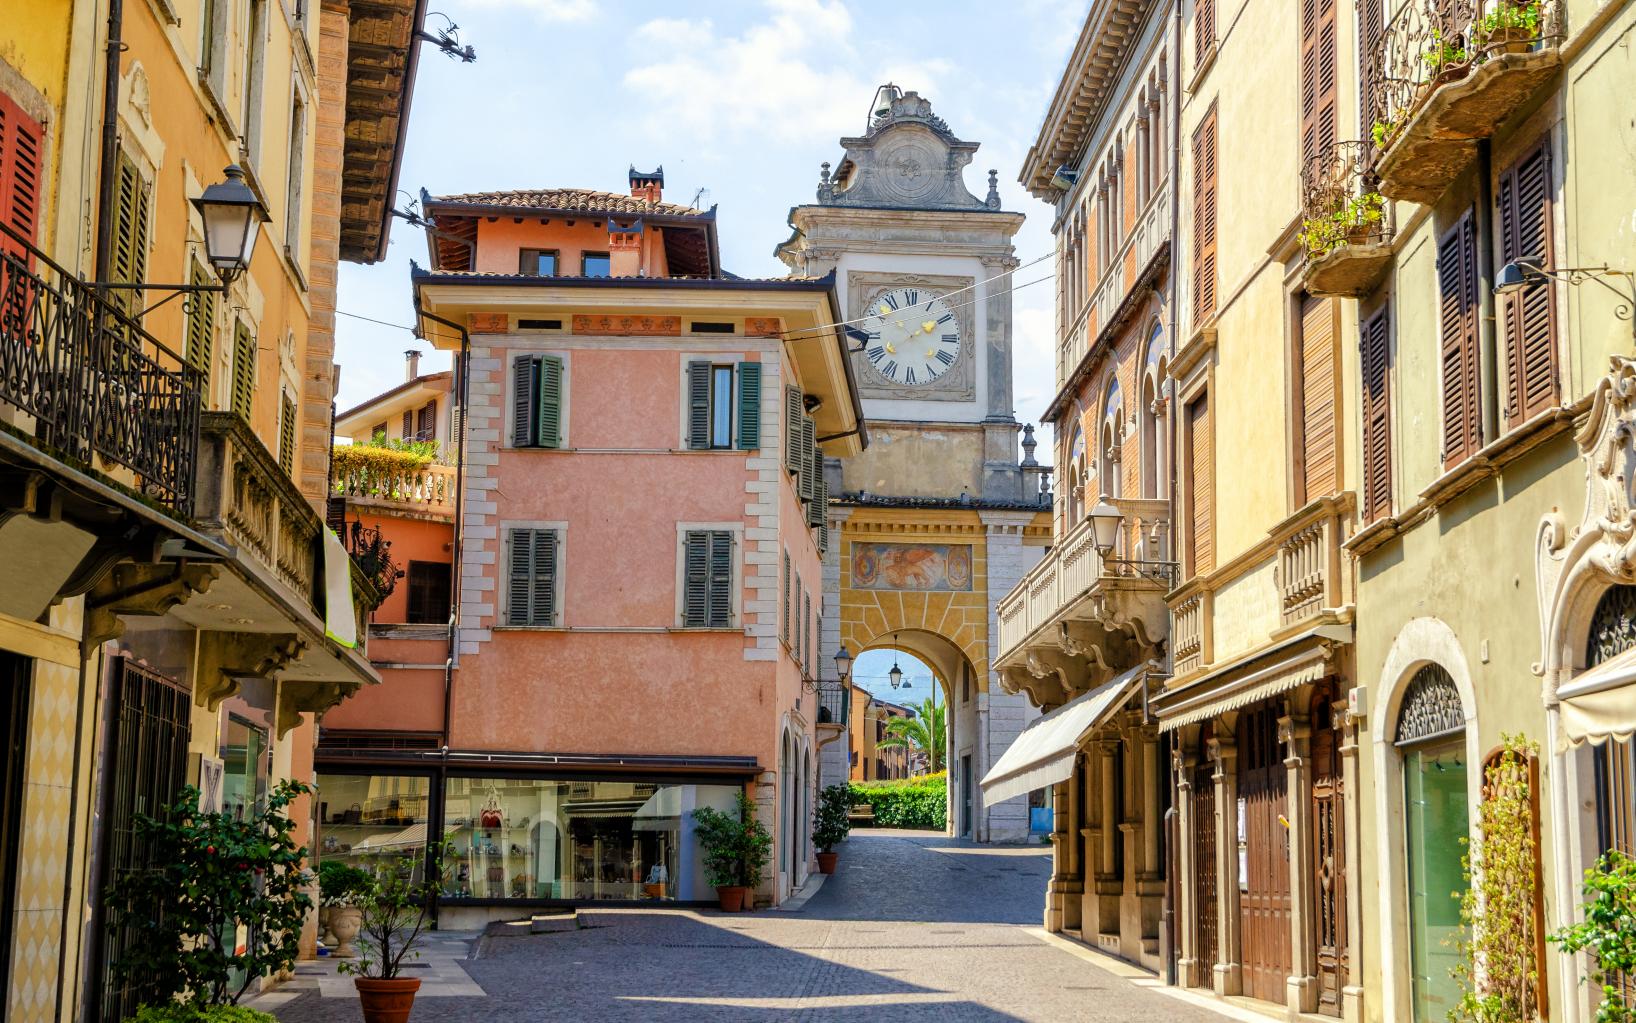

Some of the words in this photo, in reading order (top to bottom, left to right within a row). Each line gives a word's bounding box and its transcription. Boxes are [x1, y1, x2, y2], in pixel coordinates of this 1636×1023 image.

[905, 292, 917, 307] XII
[937, 314, 952, 324] II
[941, 334, 957, 343] III
[867, 346, 886, 364] VIII
[935, 349, 953, 365] IIII
[882, 360, 898, 378] VII
[906, 366, 916, 382] VI
[925, 363, 936, 377] V
